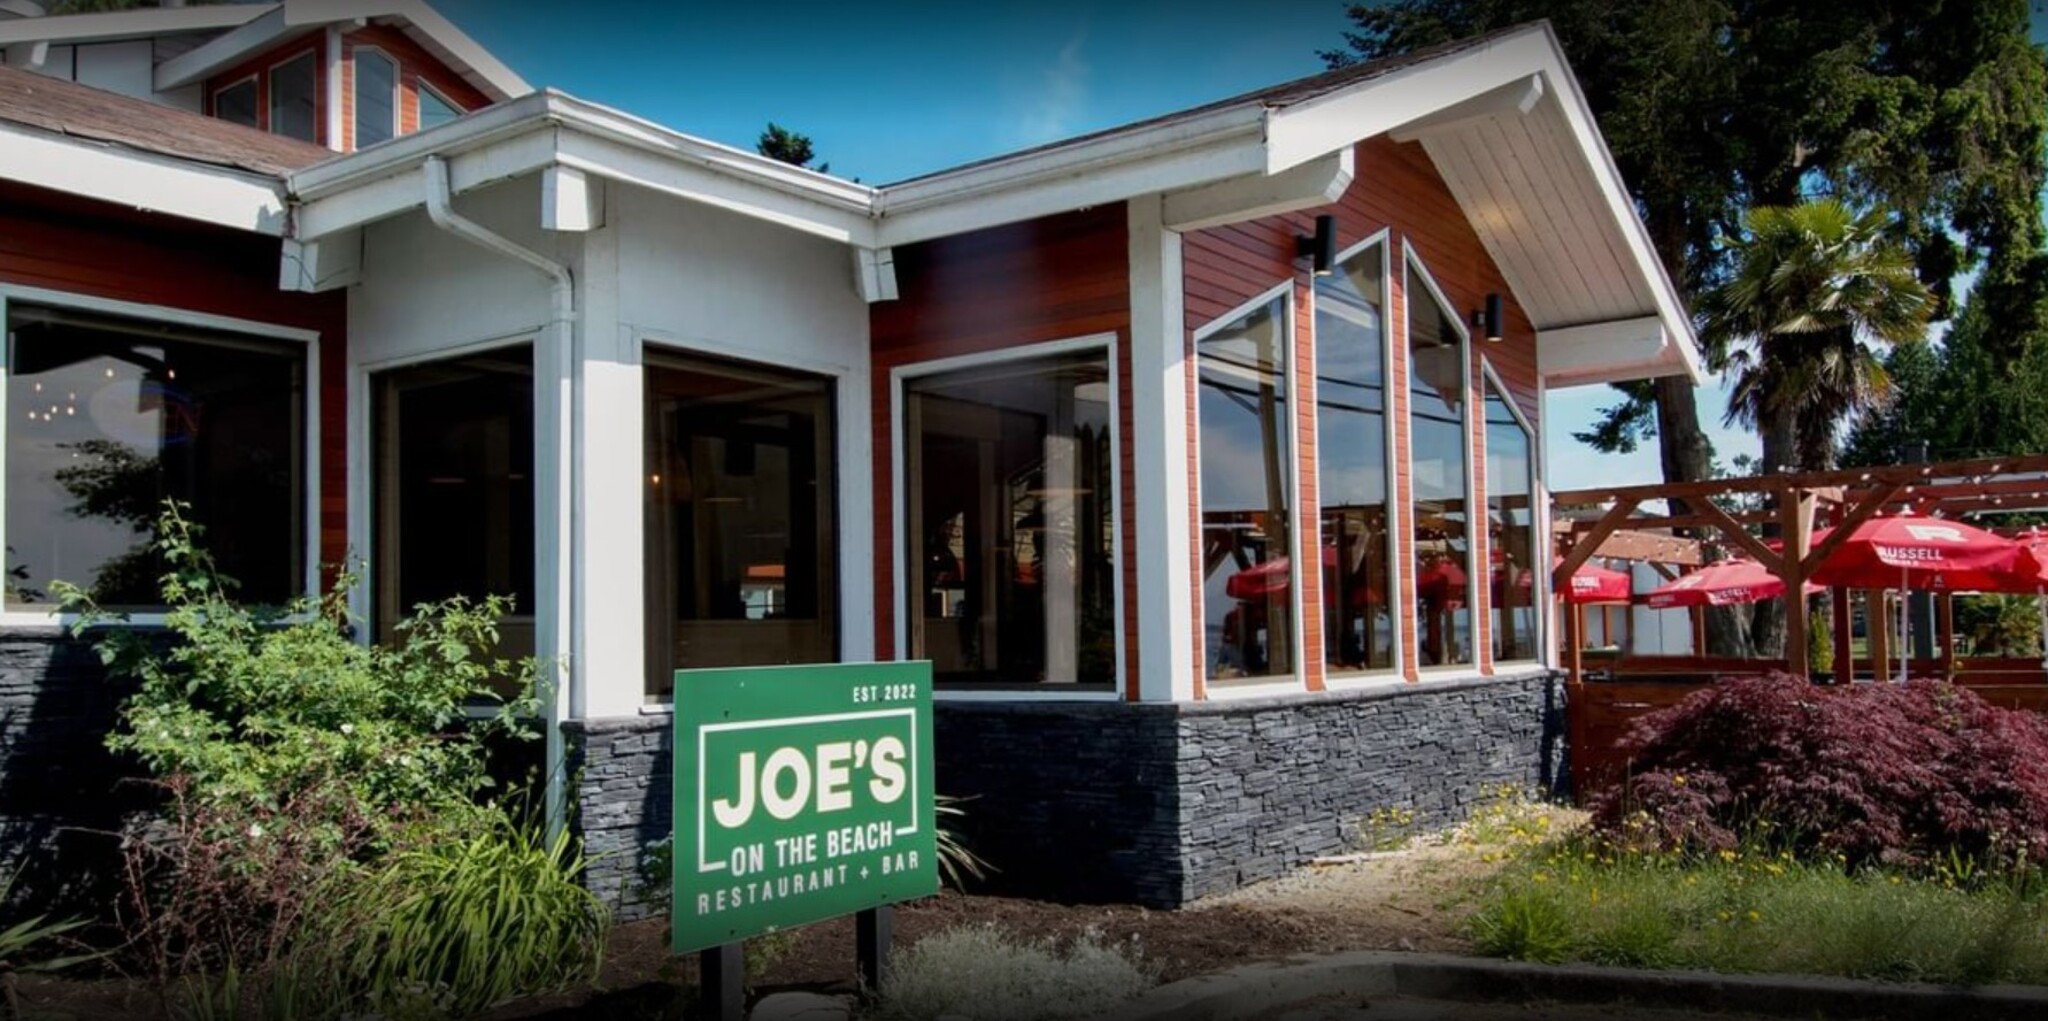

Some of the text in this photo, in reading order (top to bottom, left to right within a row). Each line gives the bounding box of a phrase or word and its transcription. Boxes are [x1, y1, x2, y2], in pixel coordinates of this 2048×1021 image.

[853, 683, 916, 702] EST 2022
[712, 736, 906, 828] JOE'S
[731, 820, 893, 877] ON THE BEACH
[698, 864, 848, 915] RESTAURANT
[882, 850, 919, 875] BAR
